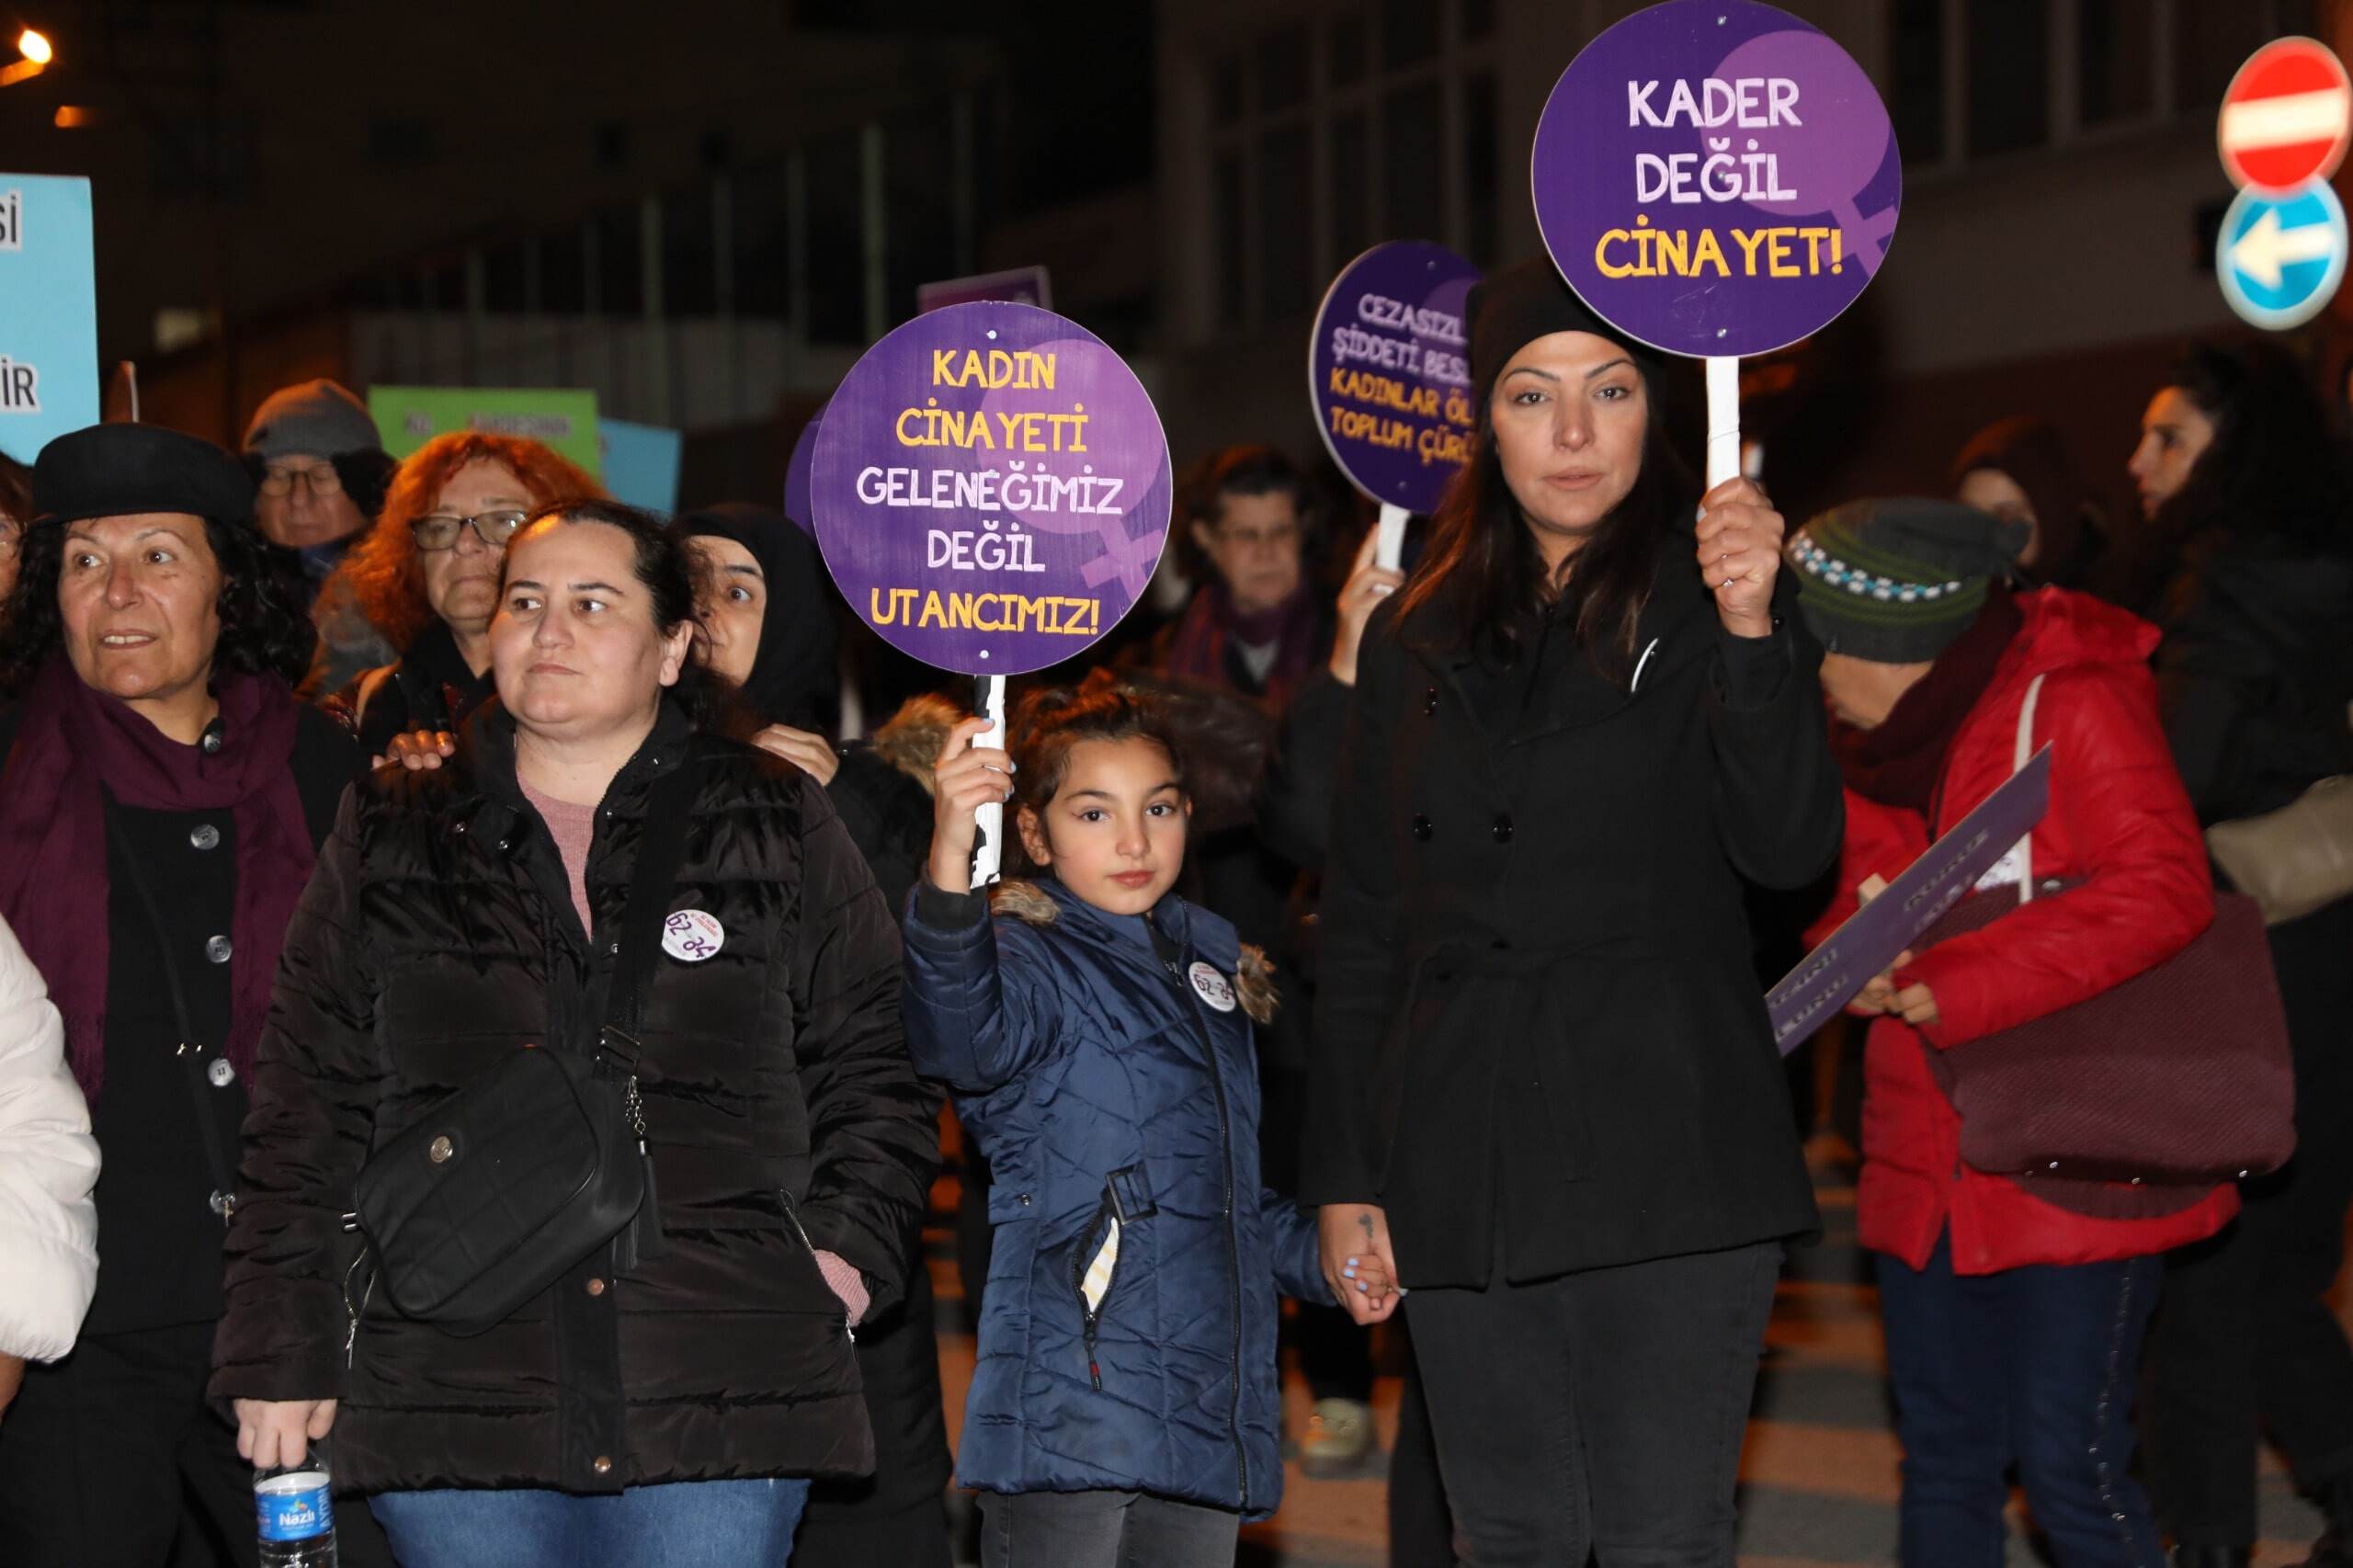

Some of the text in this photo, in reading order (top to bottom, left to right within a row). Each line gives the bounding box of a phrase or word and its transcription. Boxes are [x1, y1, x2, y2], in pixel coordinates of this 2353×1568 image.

[1628, 78, 1802, 127] KADER
[1635, 137, 1798, 203] DEĞİL
[1595, 214, 1843, 278] CİNAYET!
[932, 349, 1056, 390] KADIN
[1333, 324, 1420, 371] ŞİDDETİ
[1331, 369, 1440, 415] KADINLAR
[895, 397, 1089, 452] CİNAYETİ
[1331, 407, 1413, 449] TOPLUM
[856, 460, 1124, 515] GELENEĞİMİZ
[926, 519, 1046, 573] DEĞİL
[870, 587, 1100, 635] UTANCIMIZ!
